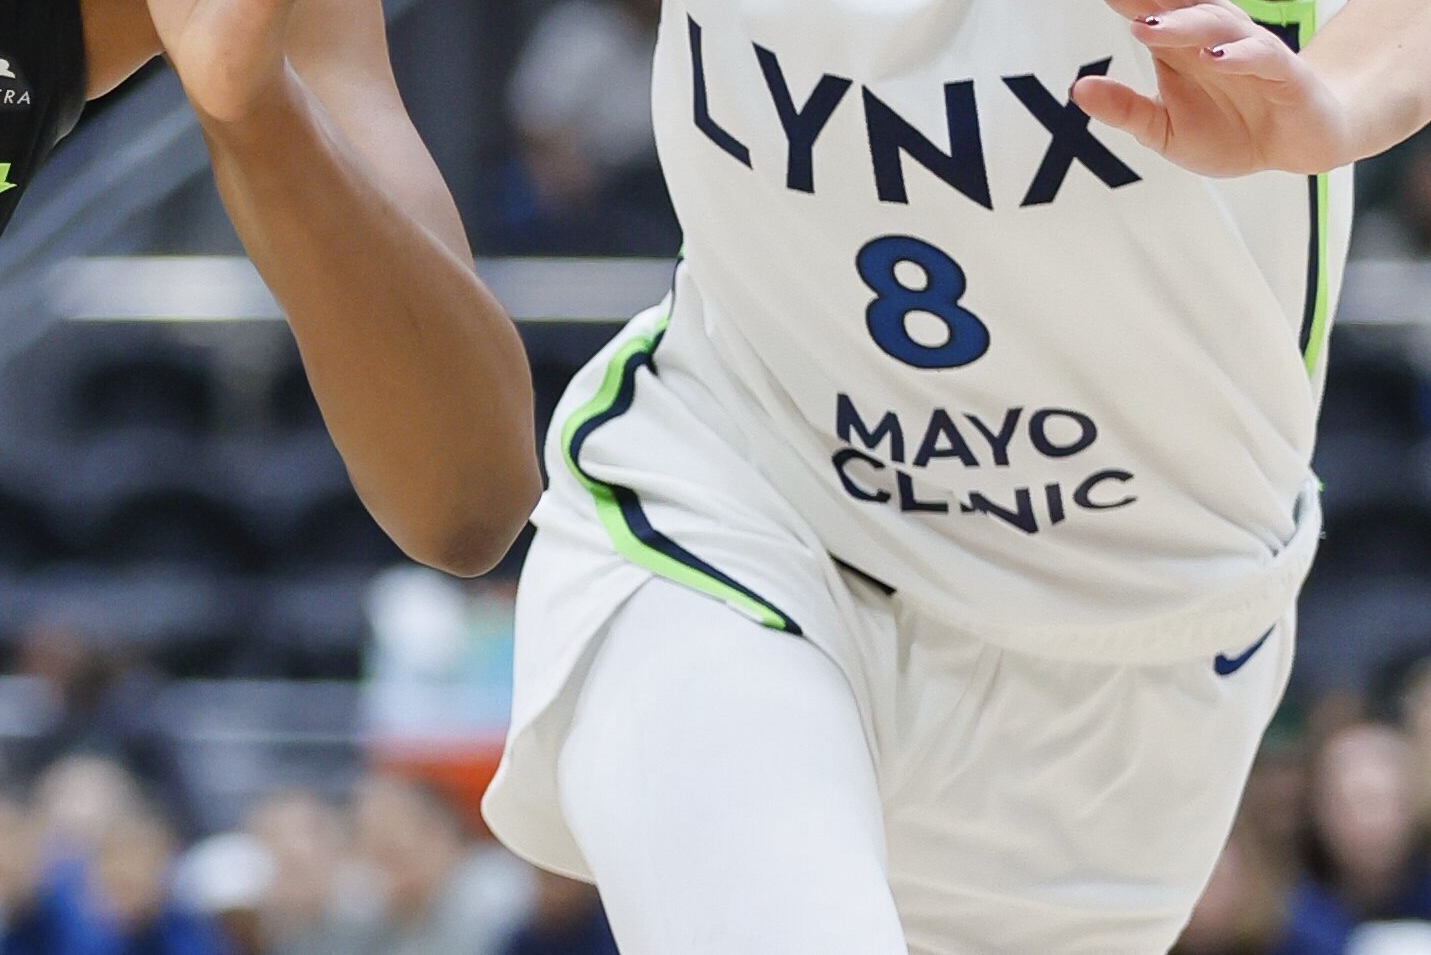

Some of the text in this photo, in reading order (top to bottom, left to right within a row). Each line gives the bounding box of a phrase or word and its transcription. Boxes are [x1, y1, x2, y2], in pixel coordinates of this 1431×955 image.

[686, 12, 1143, 211] LYNX
[855, 234, 991, 370] 8
[836, 392, 1098, 468] MAYO
[831, 448, 1137, 535] CLNIC
